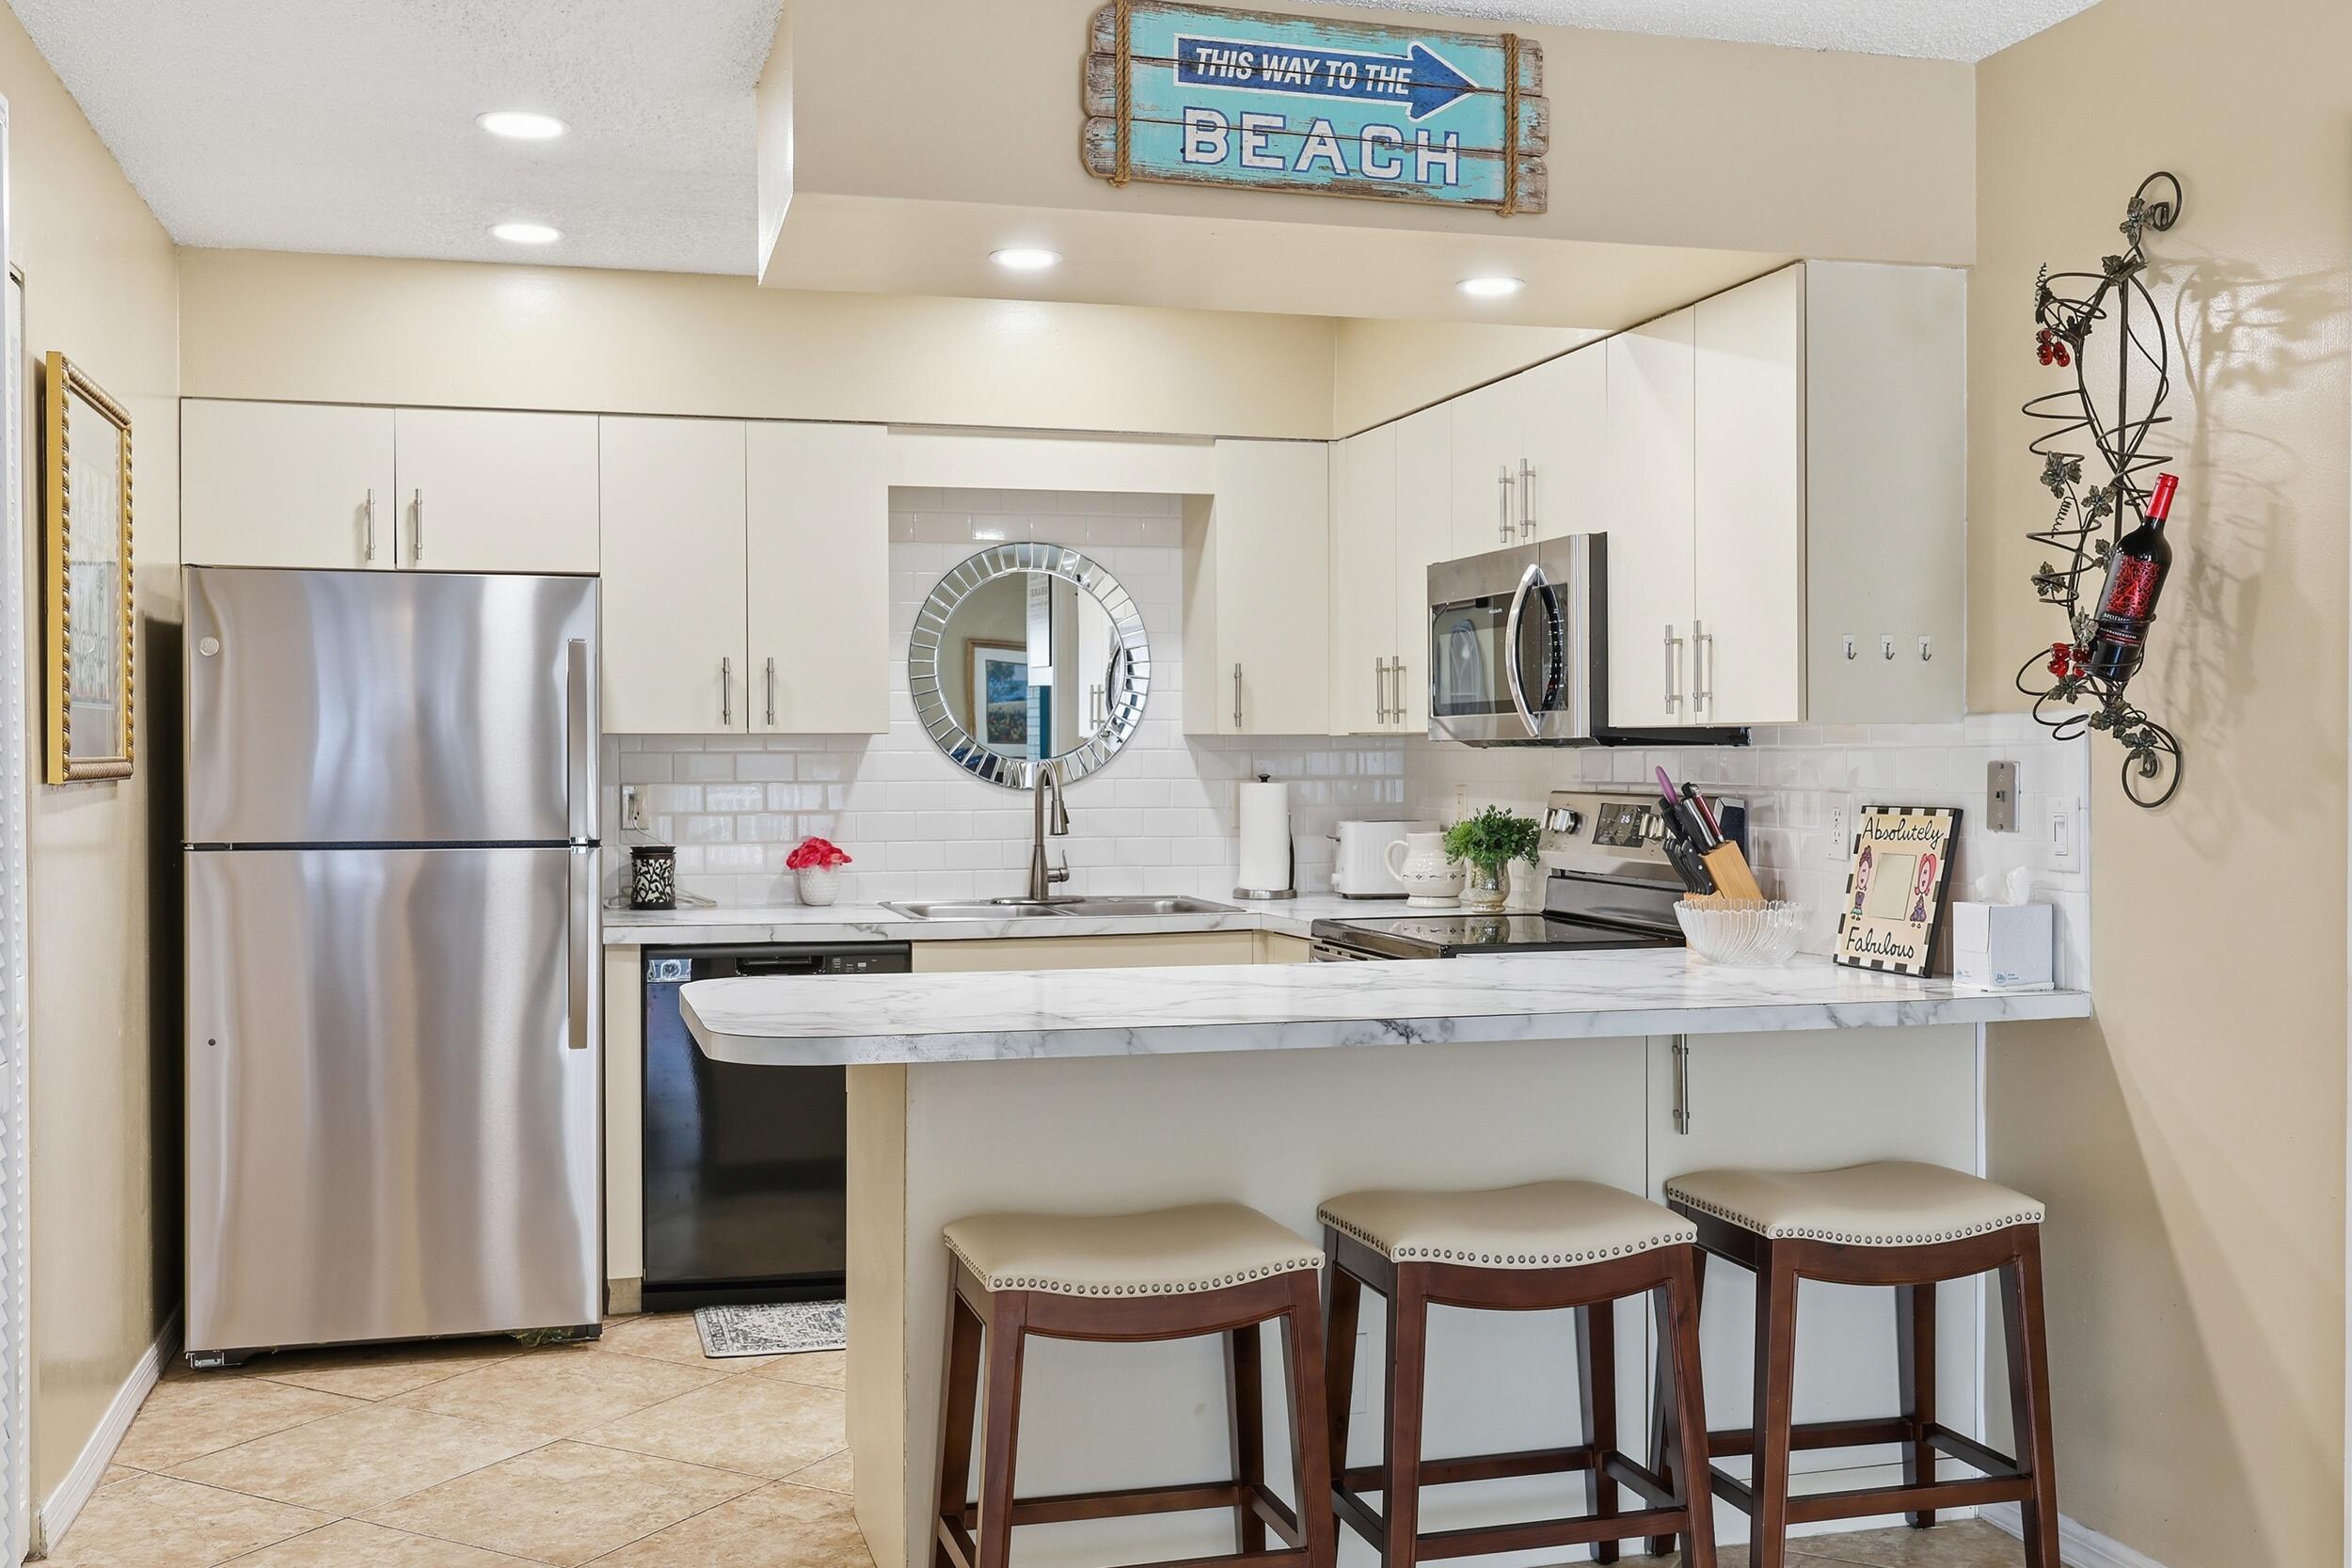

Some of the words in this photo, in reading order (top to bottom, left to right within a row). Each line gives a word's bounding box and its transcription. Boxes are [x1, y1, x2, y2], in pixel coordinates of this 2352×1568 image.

[1195, 47, 1254, 80] THIS
[1262, 54, 1321, 86] WAY
[1326, 59, 1359, 89] TO
[1365, 63, 1413, 96] THE
[1183, 105, 1461, 186] BEACH
[1862, 816, 1945, 850] Absolutely
[1846, 926, 1915, 958] Fabulous
